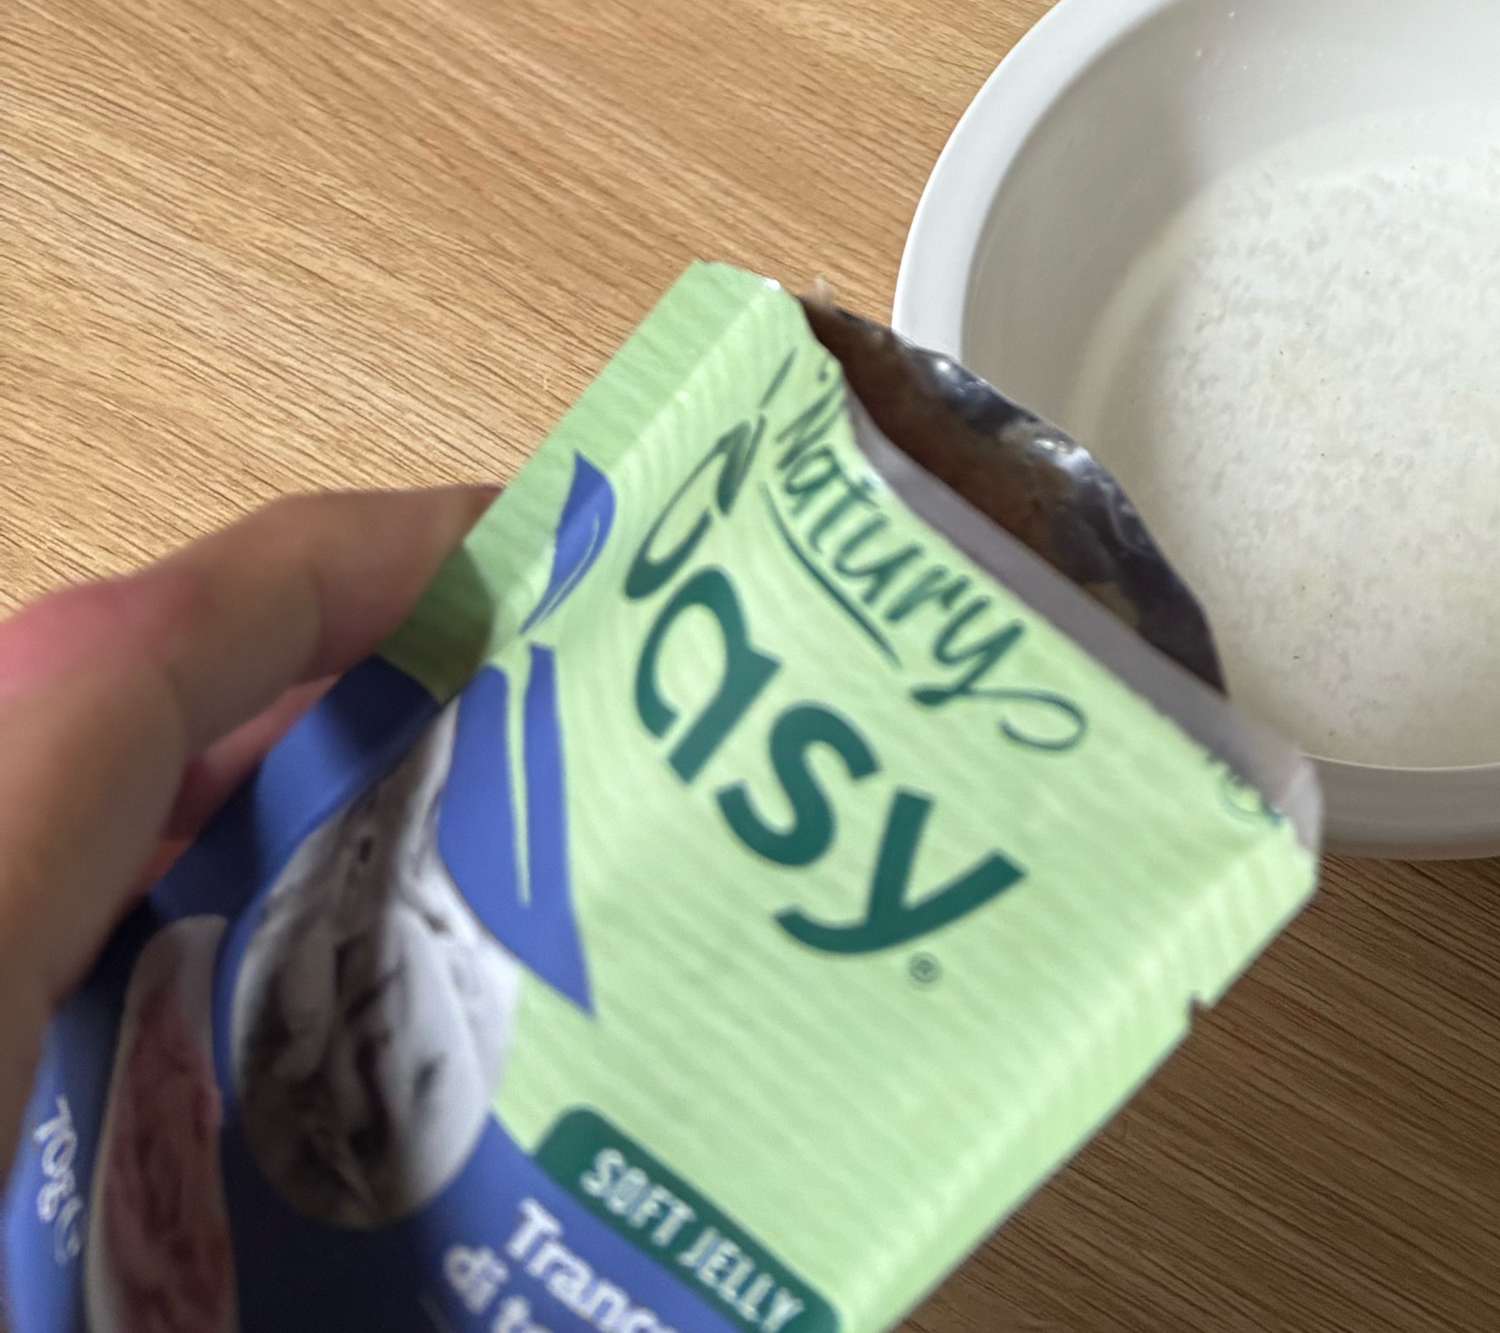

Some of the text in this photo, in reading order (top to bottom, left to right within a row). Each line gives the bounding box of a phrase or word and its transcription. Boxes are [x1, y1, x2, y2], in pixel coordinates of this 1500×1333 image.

[772, 351, 1089, 753] Natury
[443, 1244, 509, 1315] di
[579, 1147, 805, 1333] SOFT JELLY
